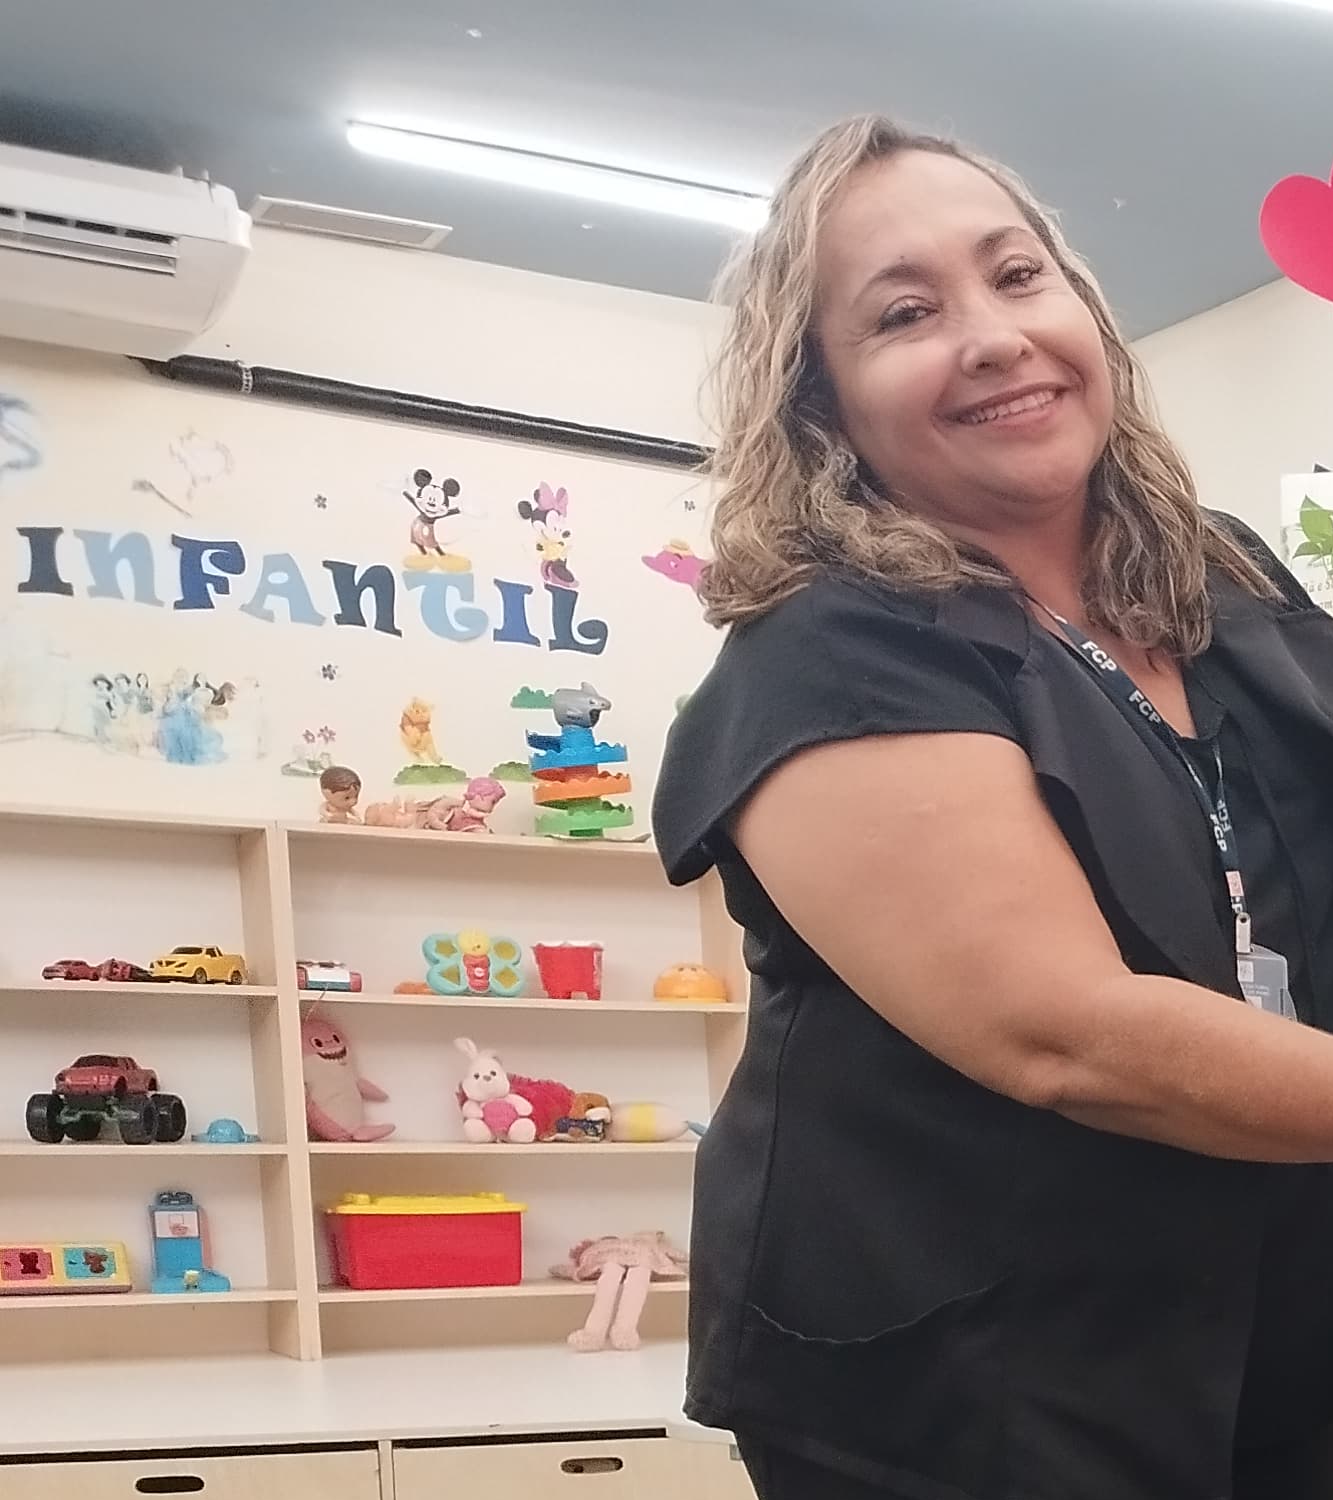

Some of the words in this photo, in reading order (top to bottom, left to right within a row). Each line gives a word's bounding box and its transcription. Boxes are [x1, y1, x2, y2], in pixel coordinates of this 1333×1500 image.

[17, 526, 609, 655] INFANTIL
[1081, 640, 1117, 671] FCP
[1129, 690, 1161, 723] FCP
[1210, 813, 1228, 852] FCP
